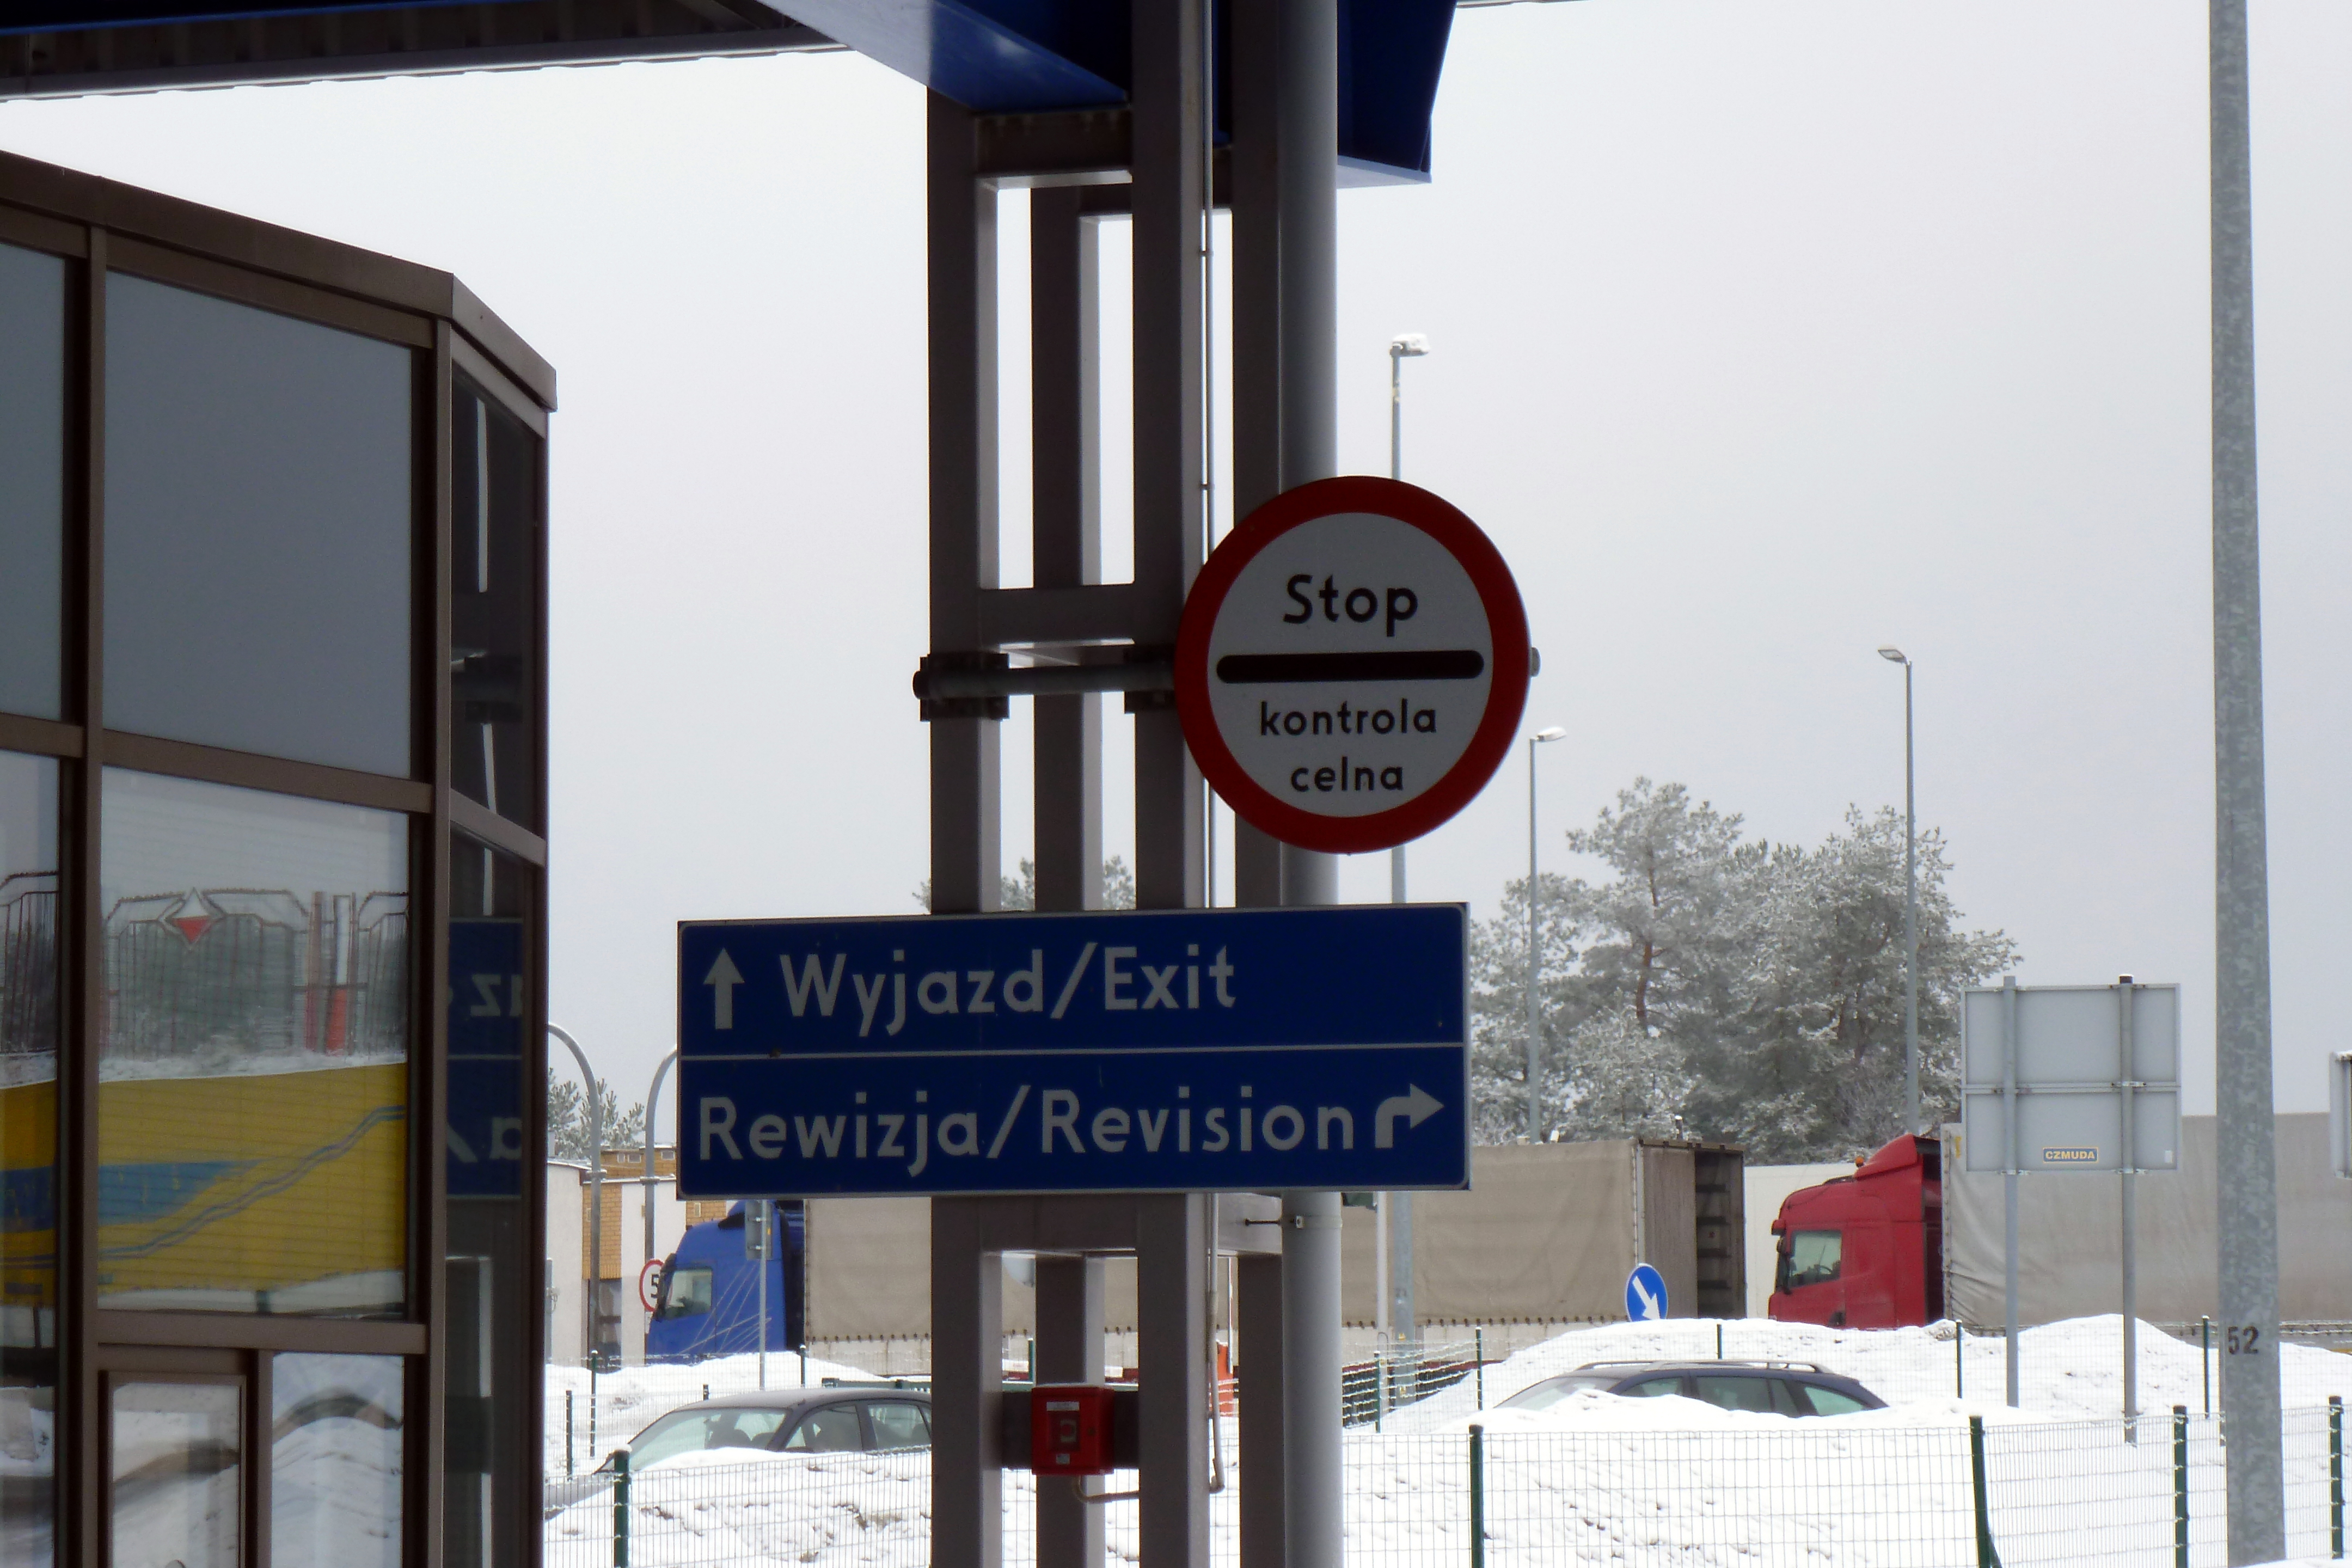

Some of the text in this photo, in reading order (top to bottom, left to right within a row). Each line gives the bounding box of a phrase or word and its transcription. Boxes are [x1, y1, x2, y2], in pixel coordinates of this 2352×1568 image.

[1283, 574, 1418, 637] Stop
[1261, 698, 1436, 735] kontrola
[1291, 756, 1402, 792] celna
[780, 942, 1235, 1037] Wyjazd/Exit
[700, 1085, 1353, 1177] Rewizja/Revision
[2045, 1151, 2095, 1160] CZMUDA
[2228, 1325, 2259, 1355] 52
